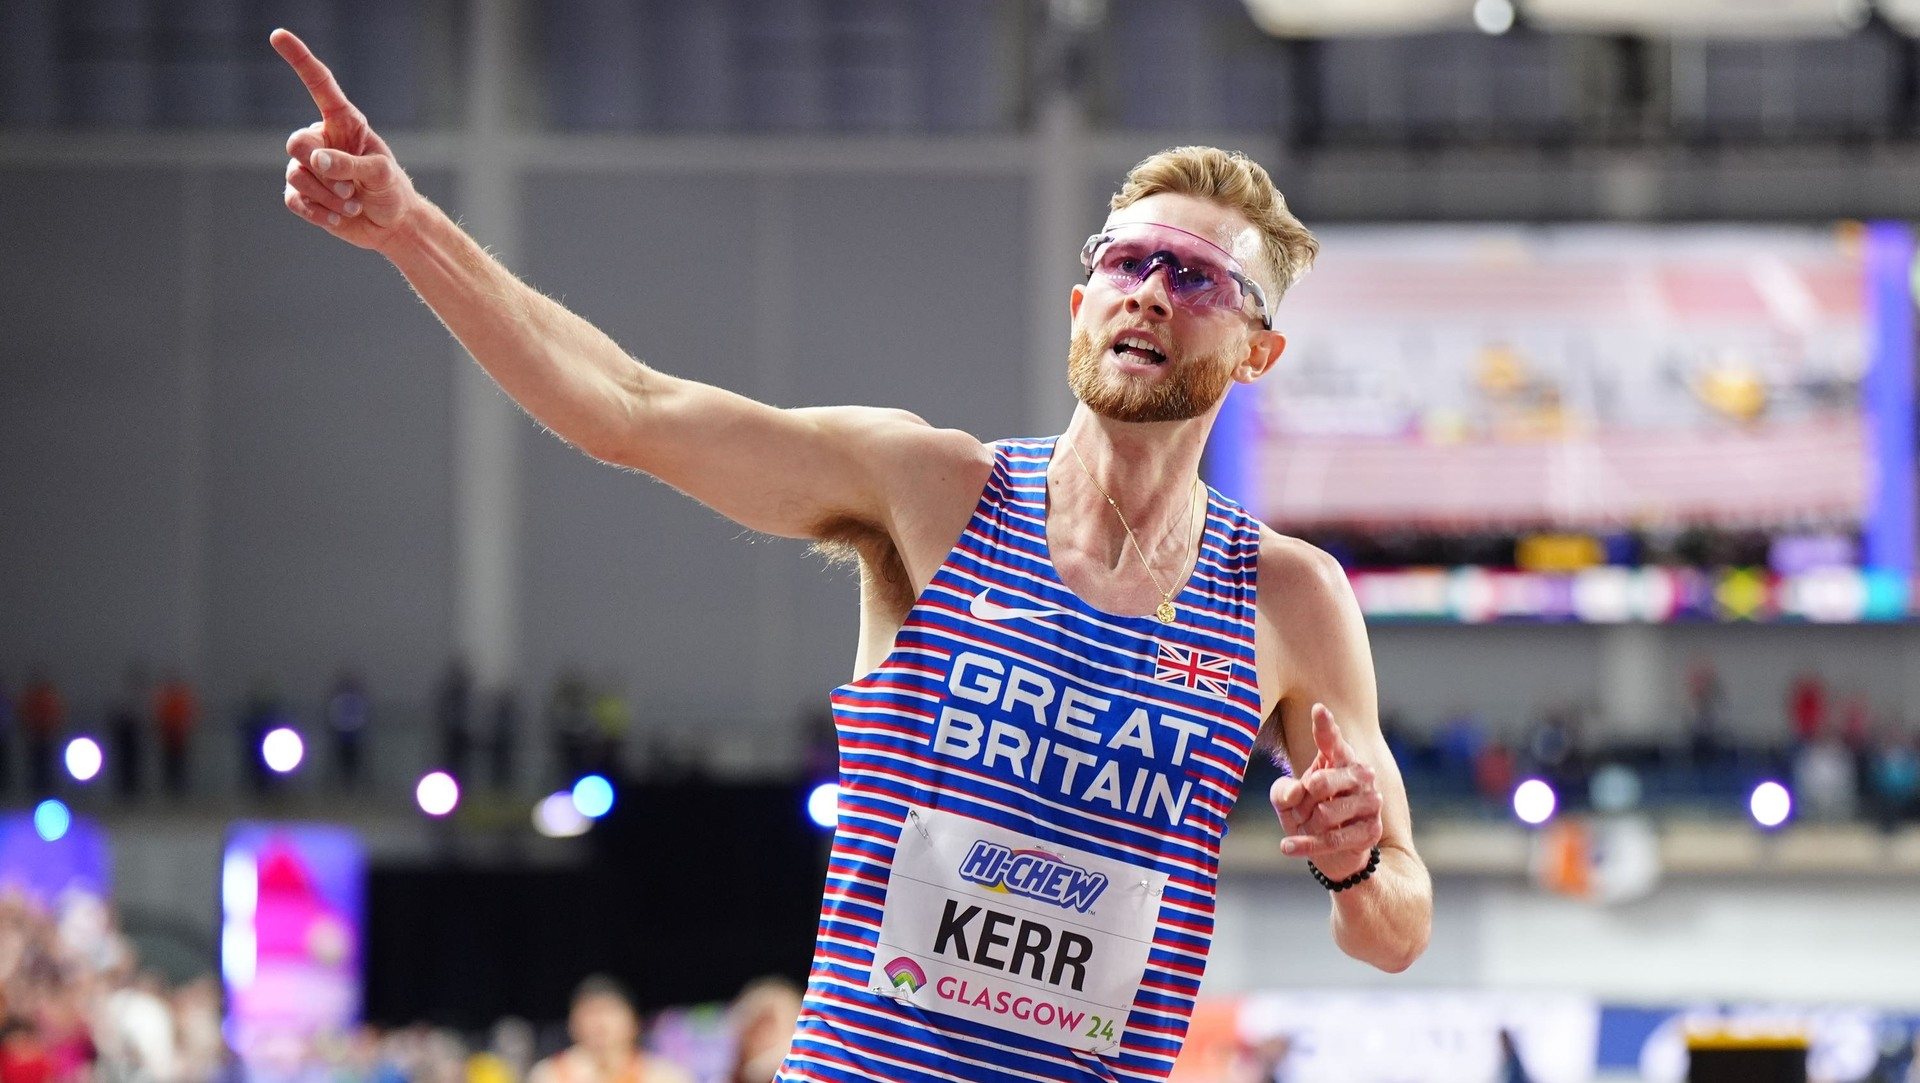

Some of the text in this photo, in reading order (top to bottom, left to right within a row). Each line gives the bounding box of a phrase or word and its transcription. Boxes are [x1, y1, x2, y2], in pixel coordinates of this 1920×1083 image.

[949, 651, 1208, 765] GREAT
[933, 705, 1193, 826] BRITAIN
[959, 840, 1108, 913] HI-CHEW
[933, 899, 1093, 992] KERR
[936, 976, 1114, 1041] GLASGOW 24
